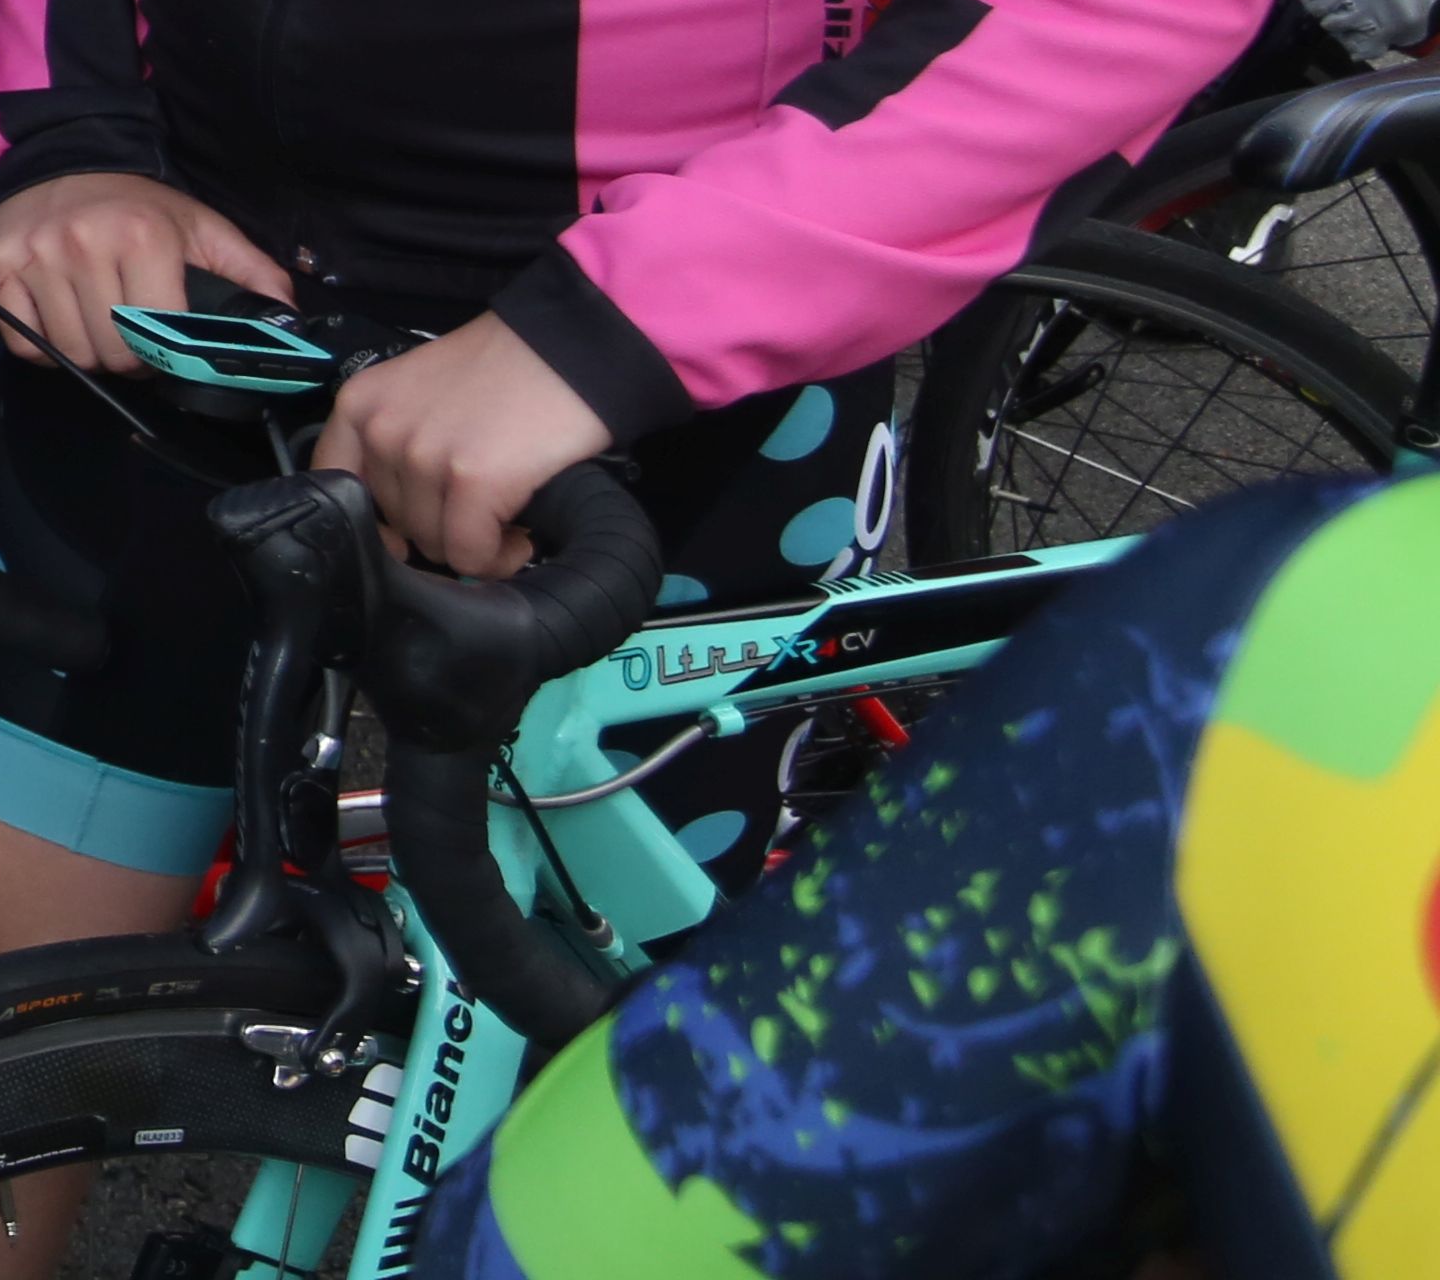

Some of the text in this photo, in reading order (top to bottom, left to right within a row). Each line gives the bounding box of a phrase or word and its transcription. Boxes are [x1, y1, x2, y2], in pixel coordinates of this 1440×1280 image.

[121, 332, 173, 372] ARMIN
[841, 630, 878, 654] CV
[15, 991, 85, 1016] SPORT
